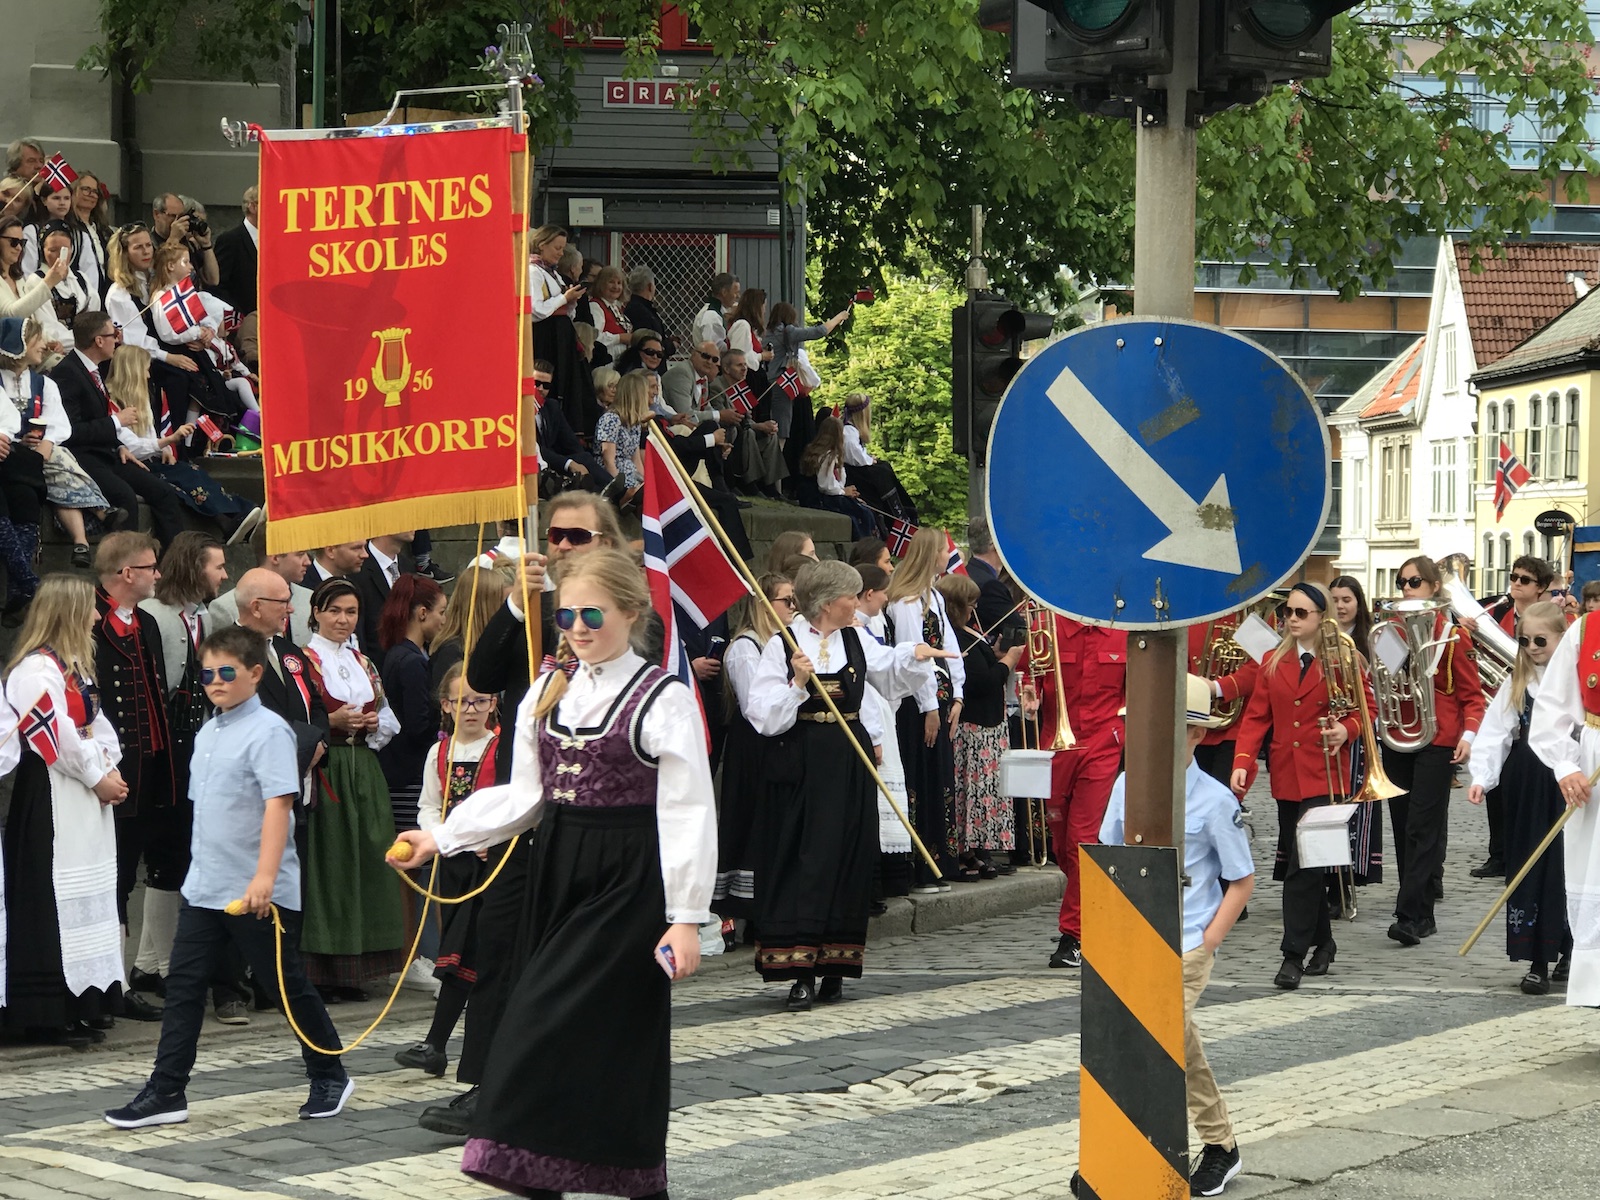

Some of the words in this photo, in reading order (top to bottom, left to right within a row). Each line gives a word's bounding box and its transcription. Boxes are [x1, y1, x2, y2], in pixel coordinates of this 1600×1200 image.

[279, 173, 492, 233] TERTNES
[309, 233, 447, 277] SKOLES
[344, 377, 368, 401] 19
[413, 369, 434, 392] 56
[272, 414, 516, 477] MUSIKKORPS
